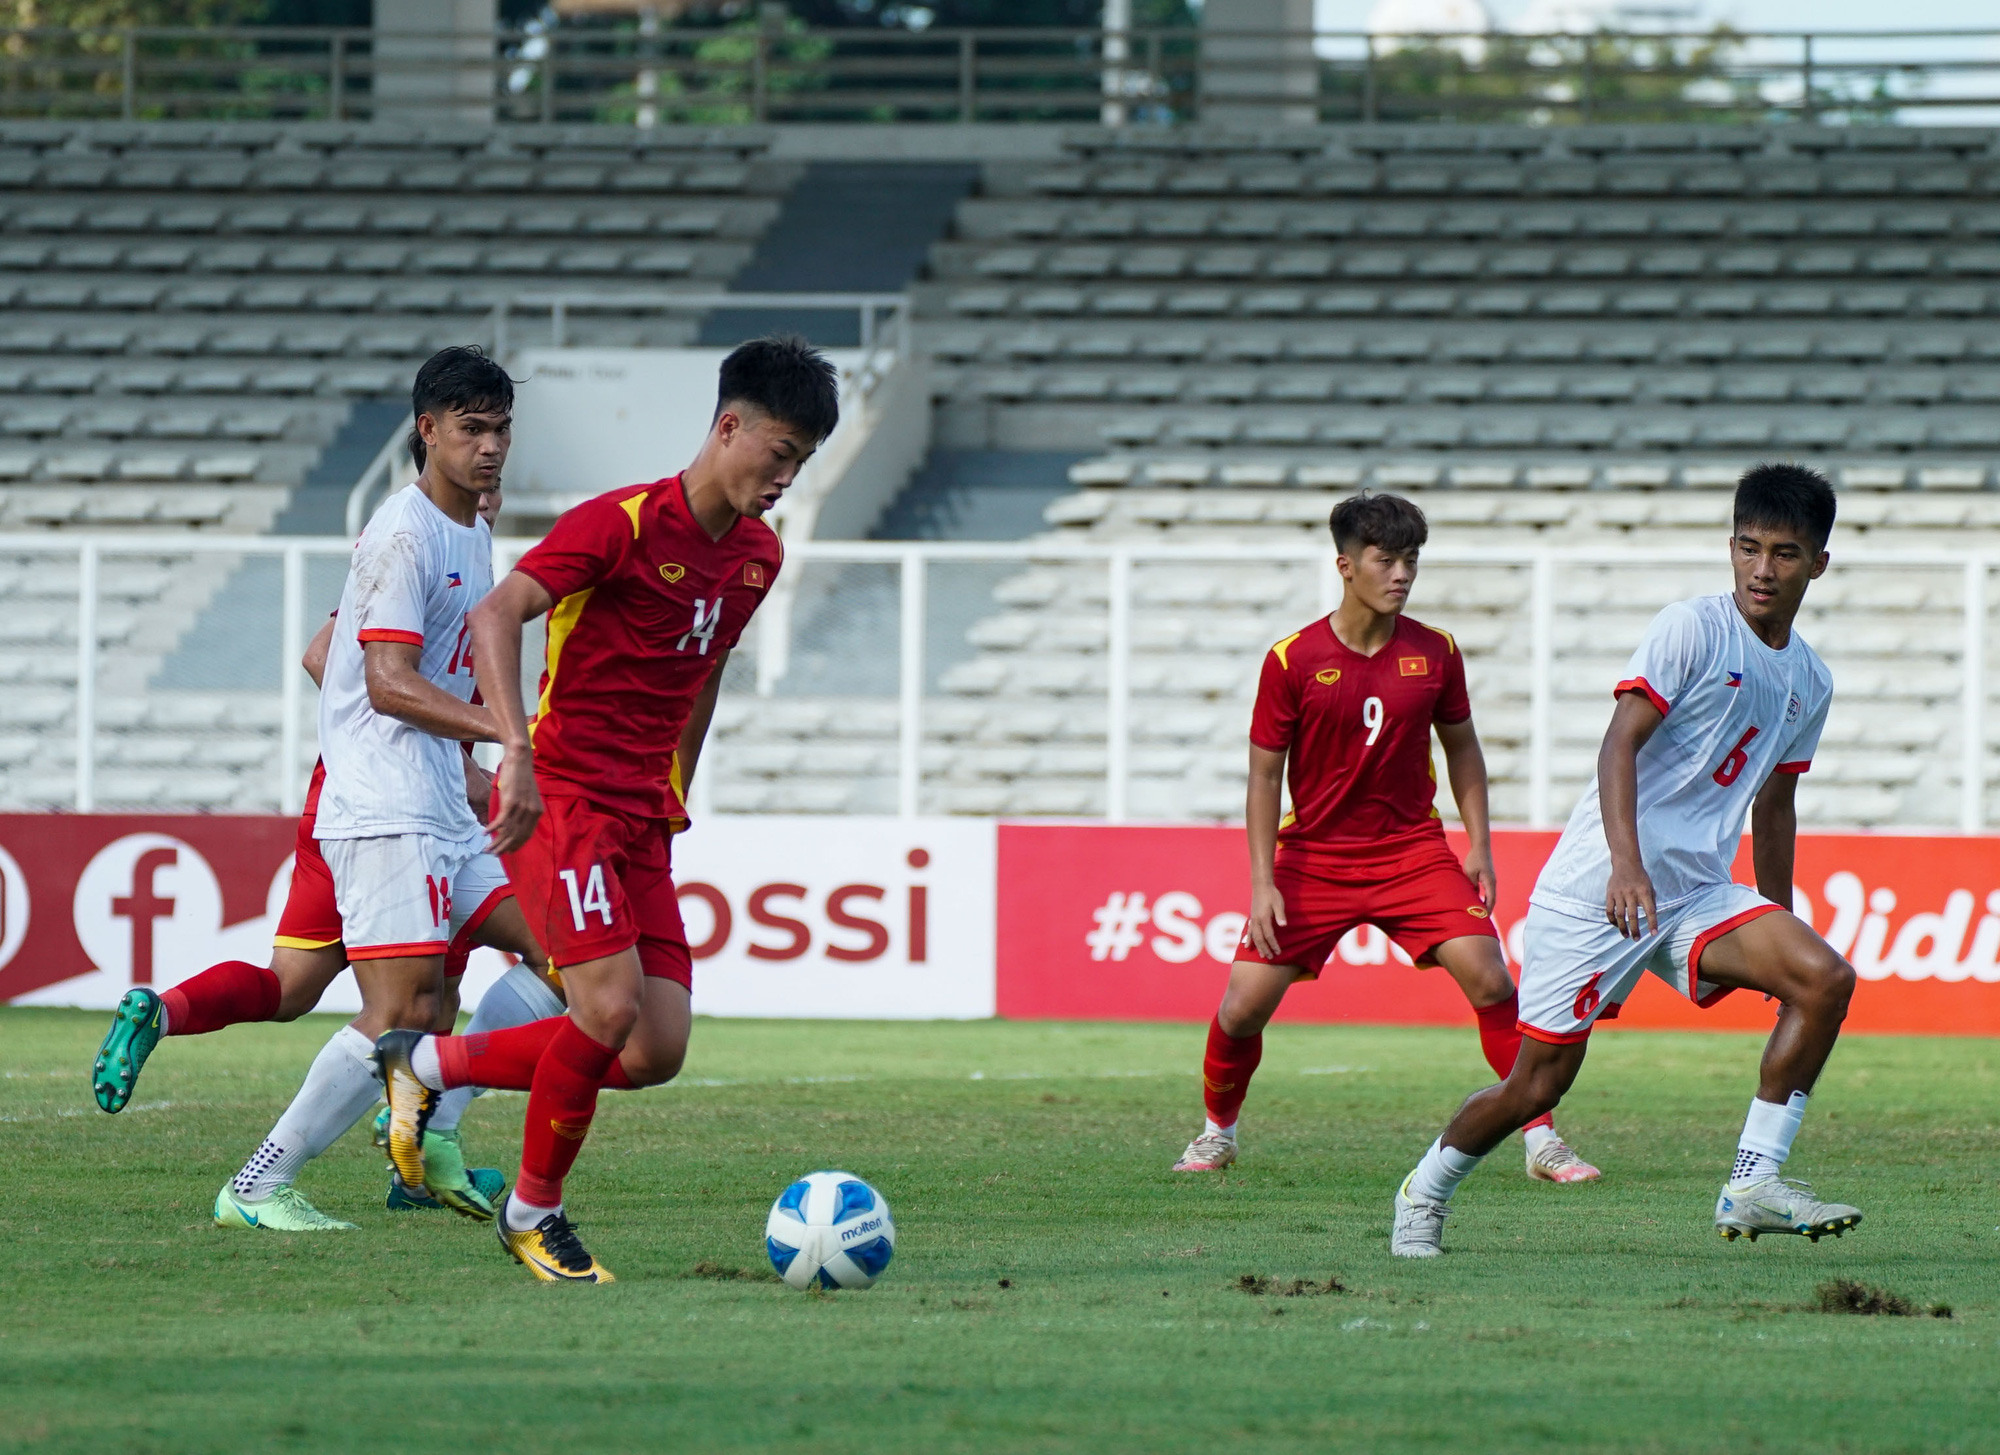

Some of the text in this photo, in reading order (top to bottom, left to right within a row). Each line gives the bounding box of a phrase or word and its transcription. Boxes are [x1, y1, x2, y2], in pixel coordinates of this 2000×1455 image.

[676, 597, 723, 655] 14
[1363, 697, 1384, 746] 9
[1713, 726, 1760, 787] 6
[559, 865, 614, 931] 14
[675, 848, 929, 962] ossi
[1573, 971, 1605, 1020] 6
[841, 1217, 882, 1241] molten
